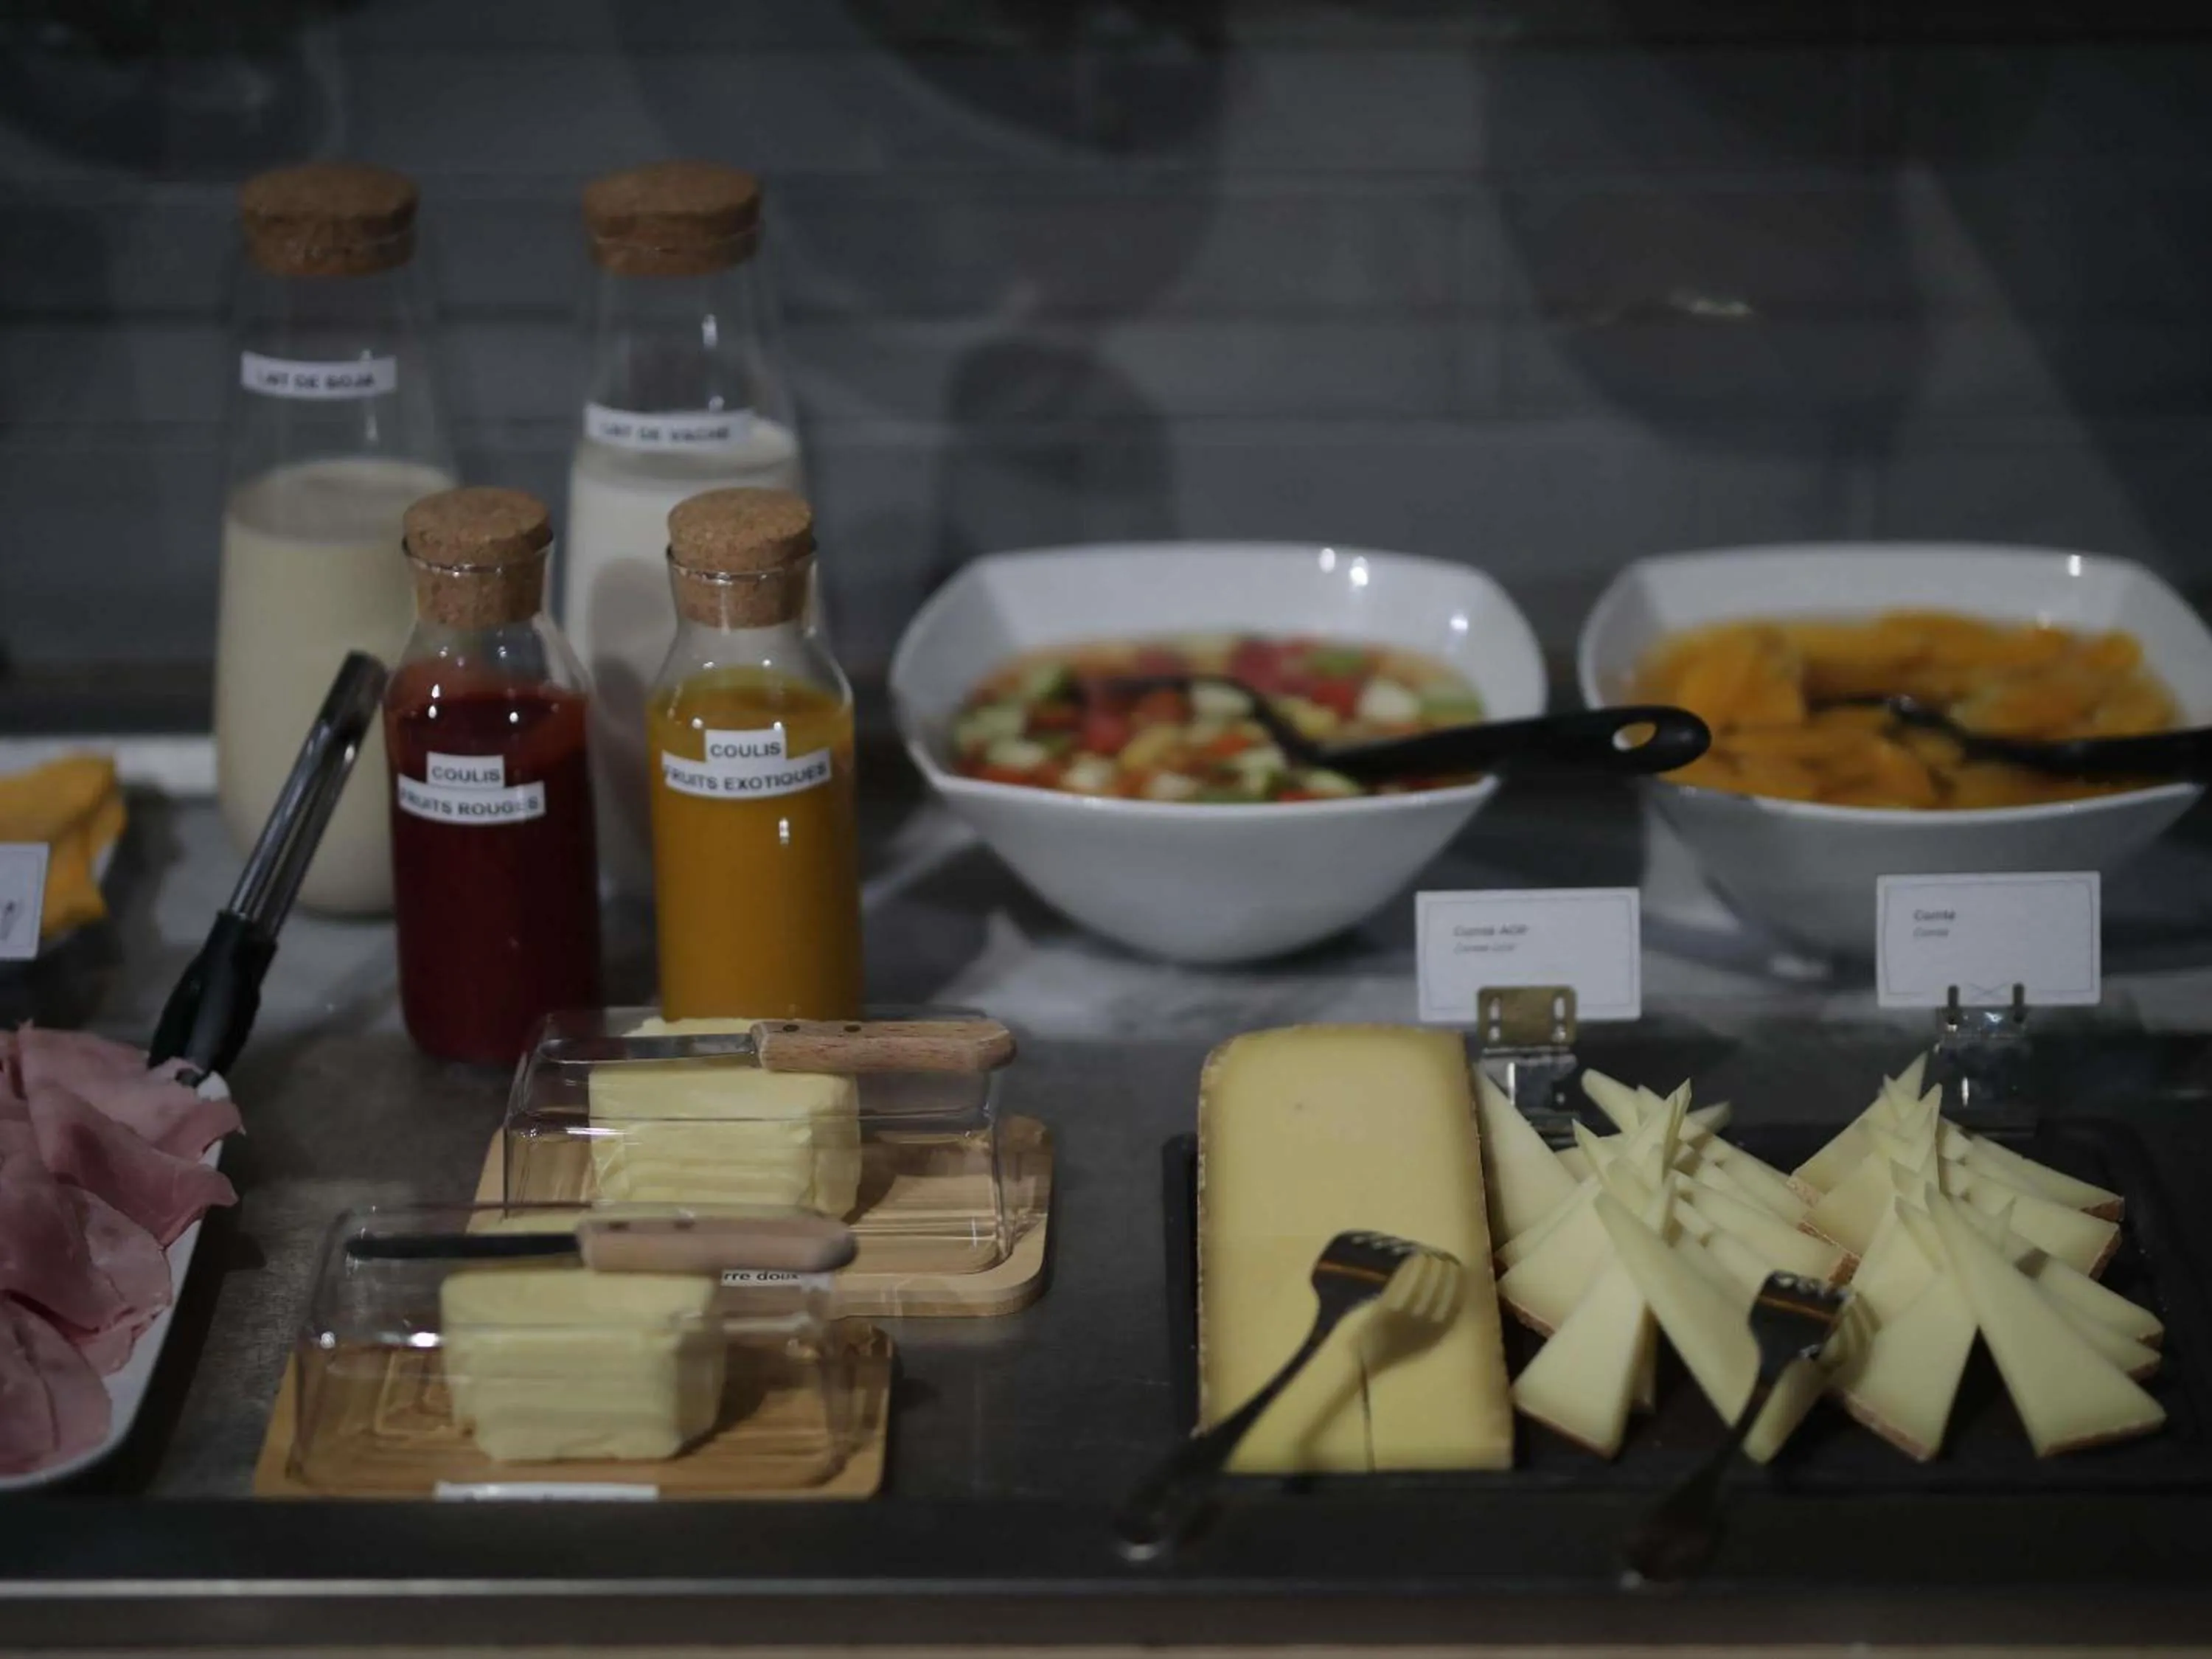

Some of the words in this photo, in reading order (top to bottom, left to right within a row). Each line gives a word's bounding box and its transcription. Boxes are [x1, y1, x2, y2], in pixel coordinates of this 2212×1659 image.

[710, 742, 782, 758] COULIS
[431, 766, 501, 783] COULIS
[724, 761, 827, 791] EXOTIQUES
[723, 1272, 751, 1281] rre
